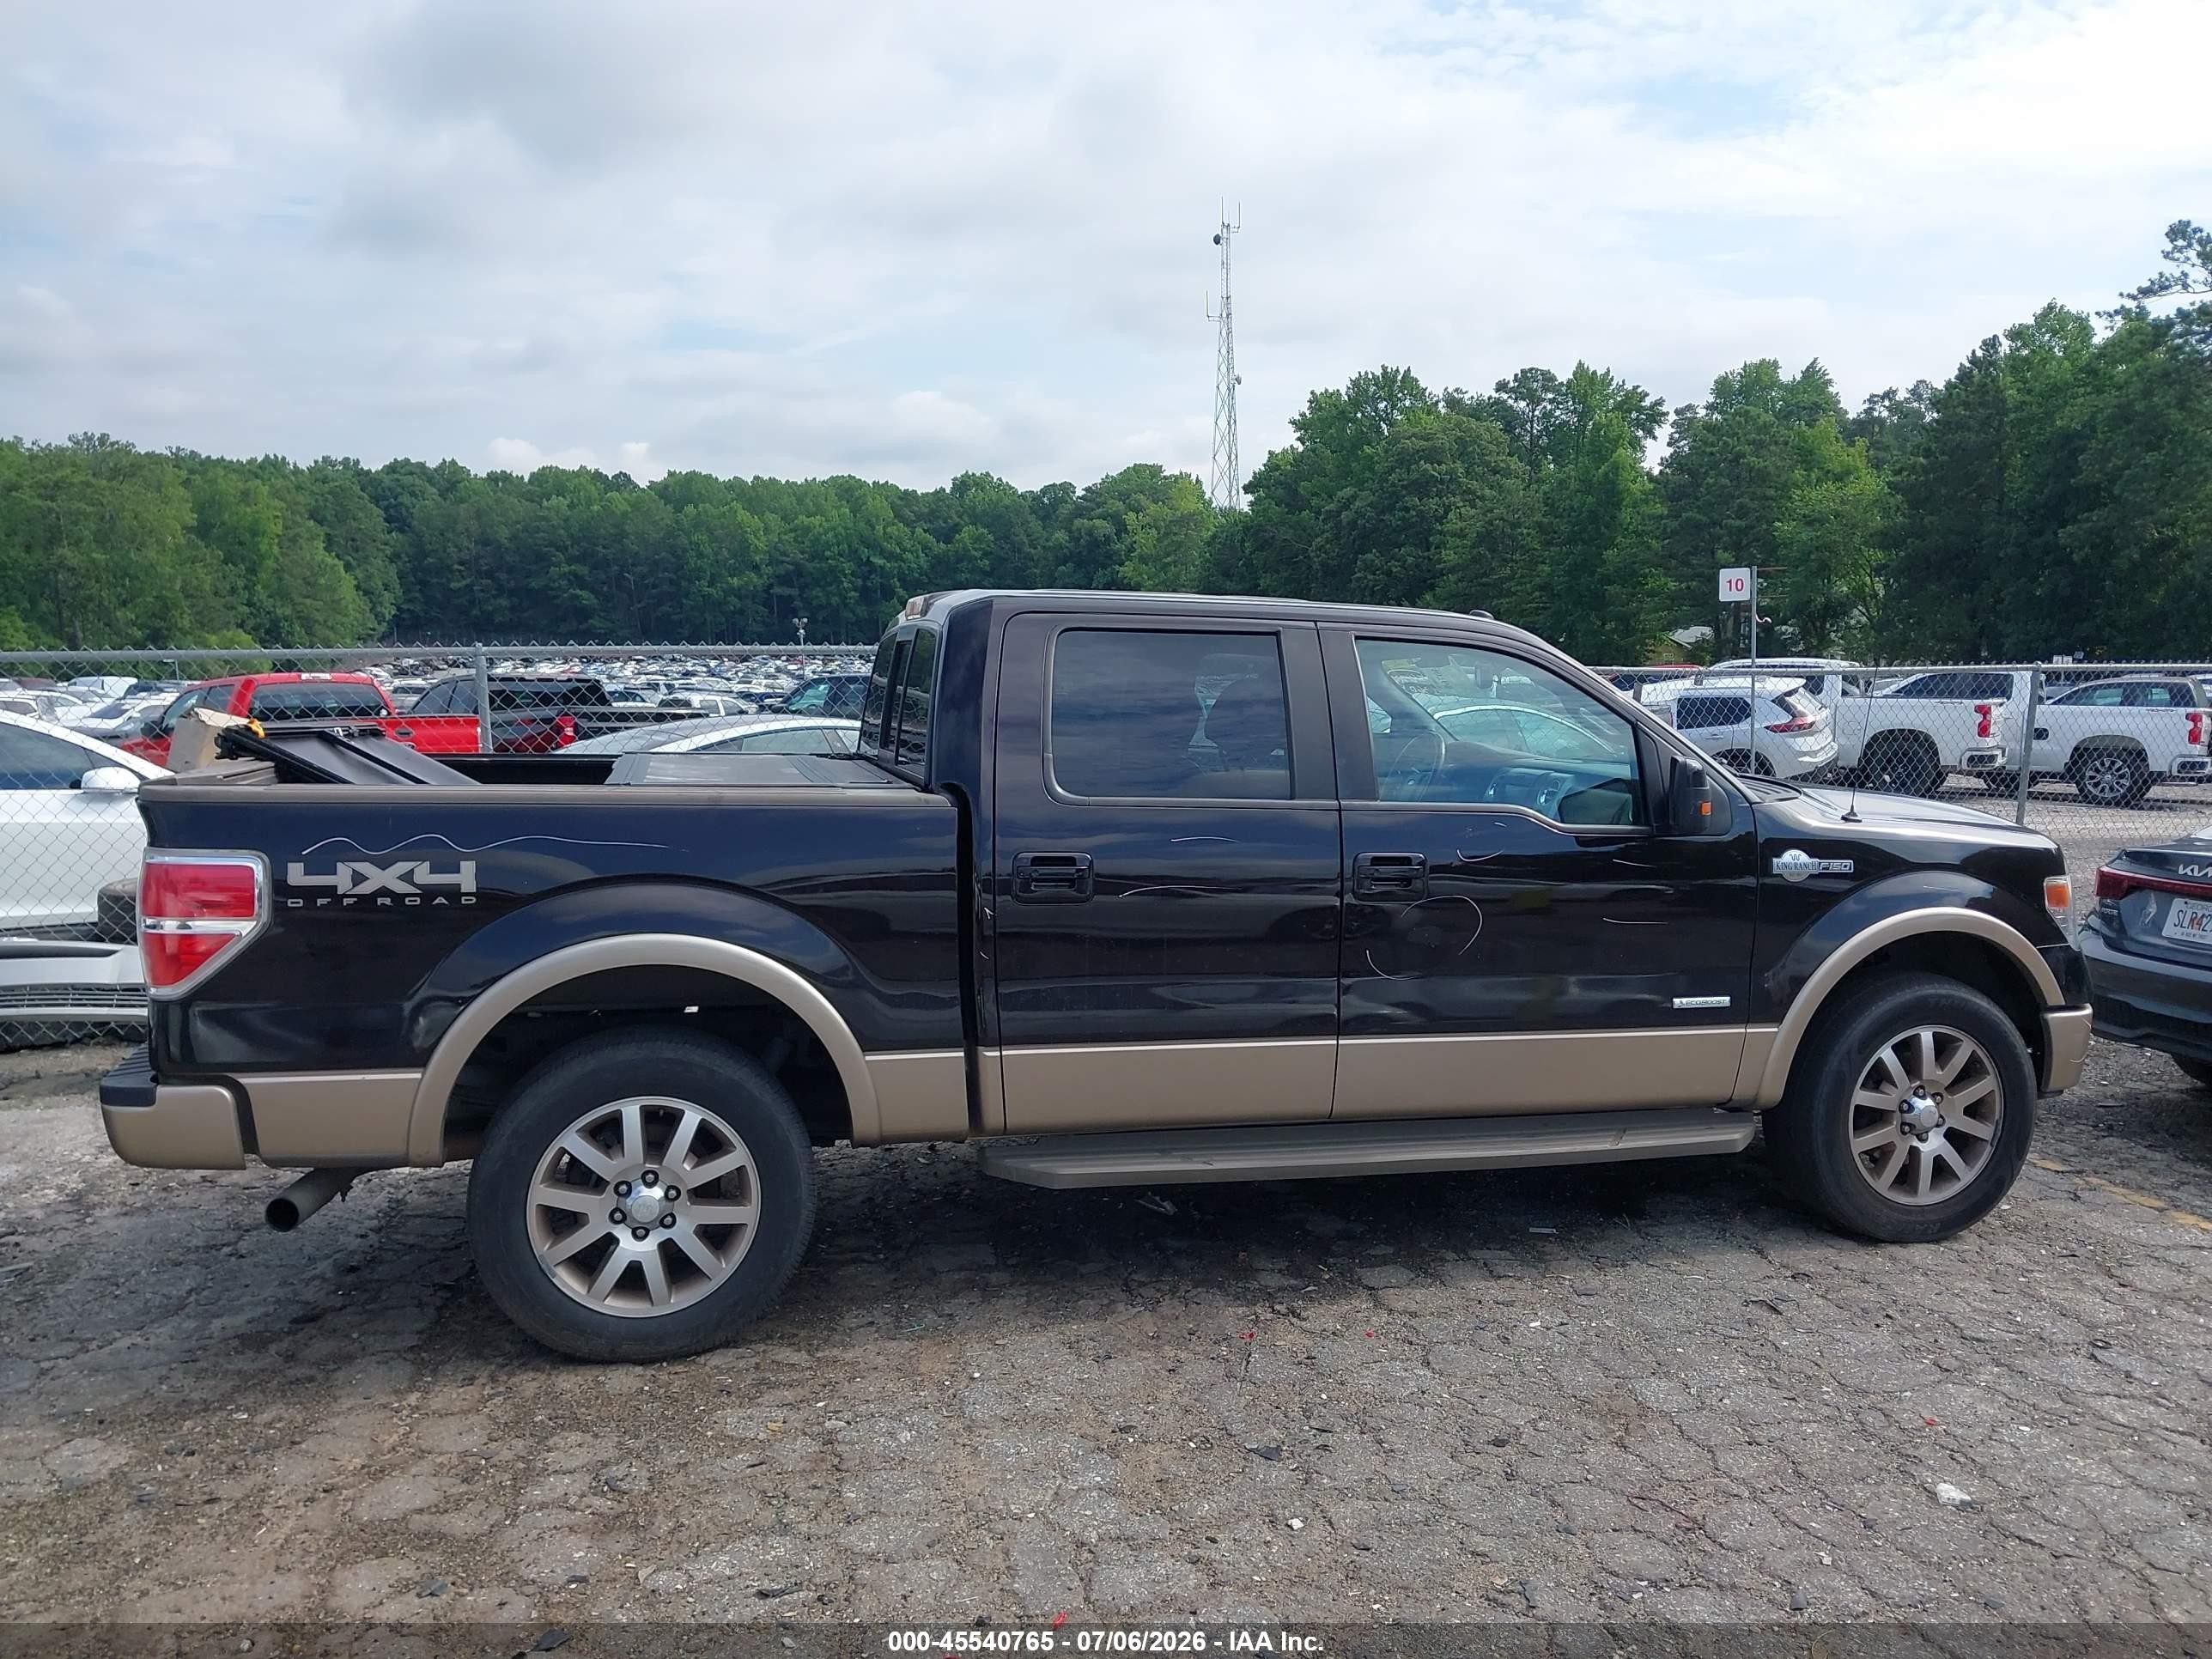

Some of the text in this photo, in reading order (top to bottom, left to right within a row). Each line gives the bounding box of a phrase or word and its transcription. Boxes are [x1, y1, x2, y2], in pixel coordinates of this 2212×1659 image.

[1726, 578, 1744, 592] 10
[1776, 860, 1817, 871] KING RANCH
[2173, 909, 2212, 933] SLR42
